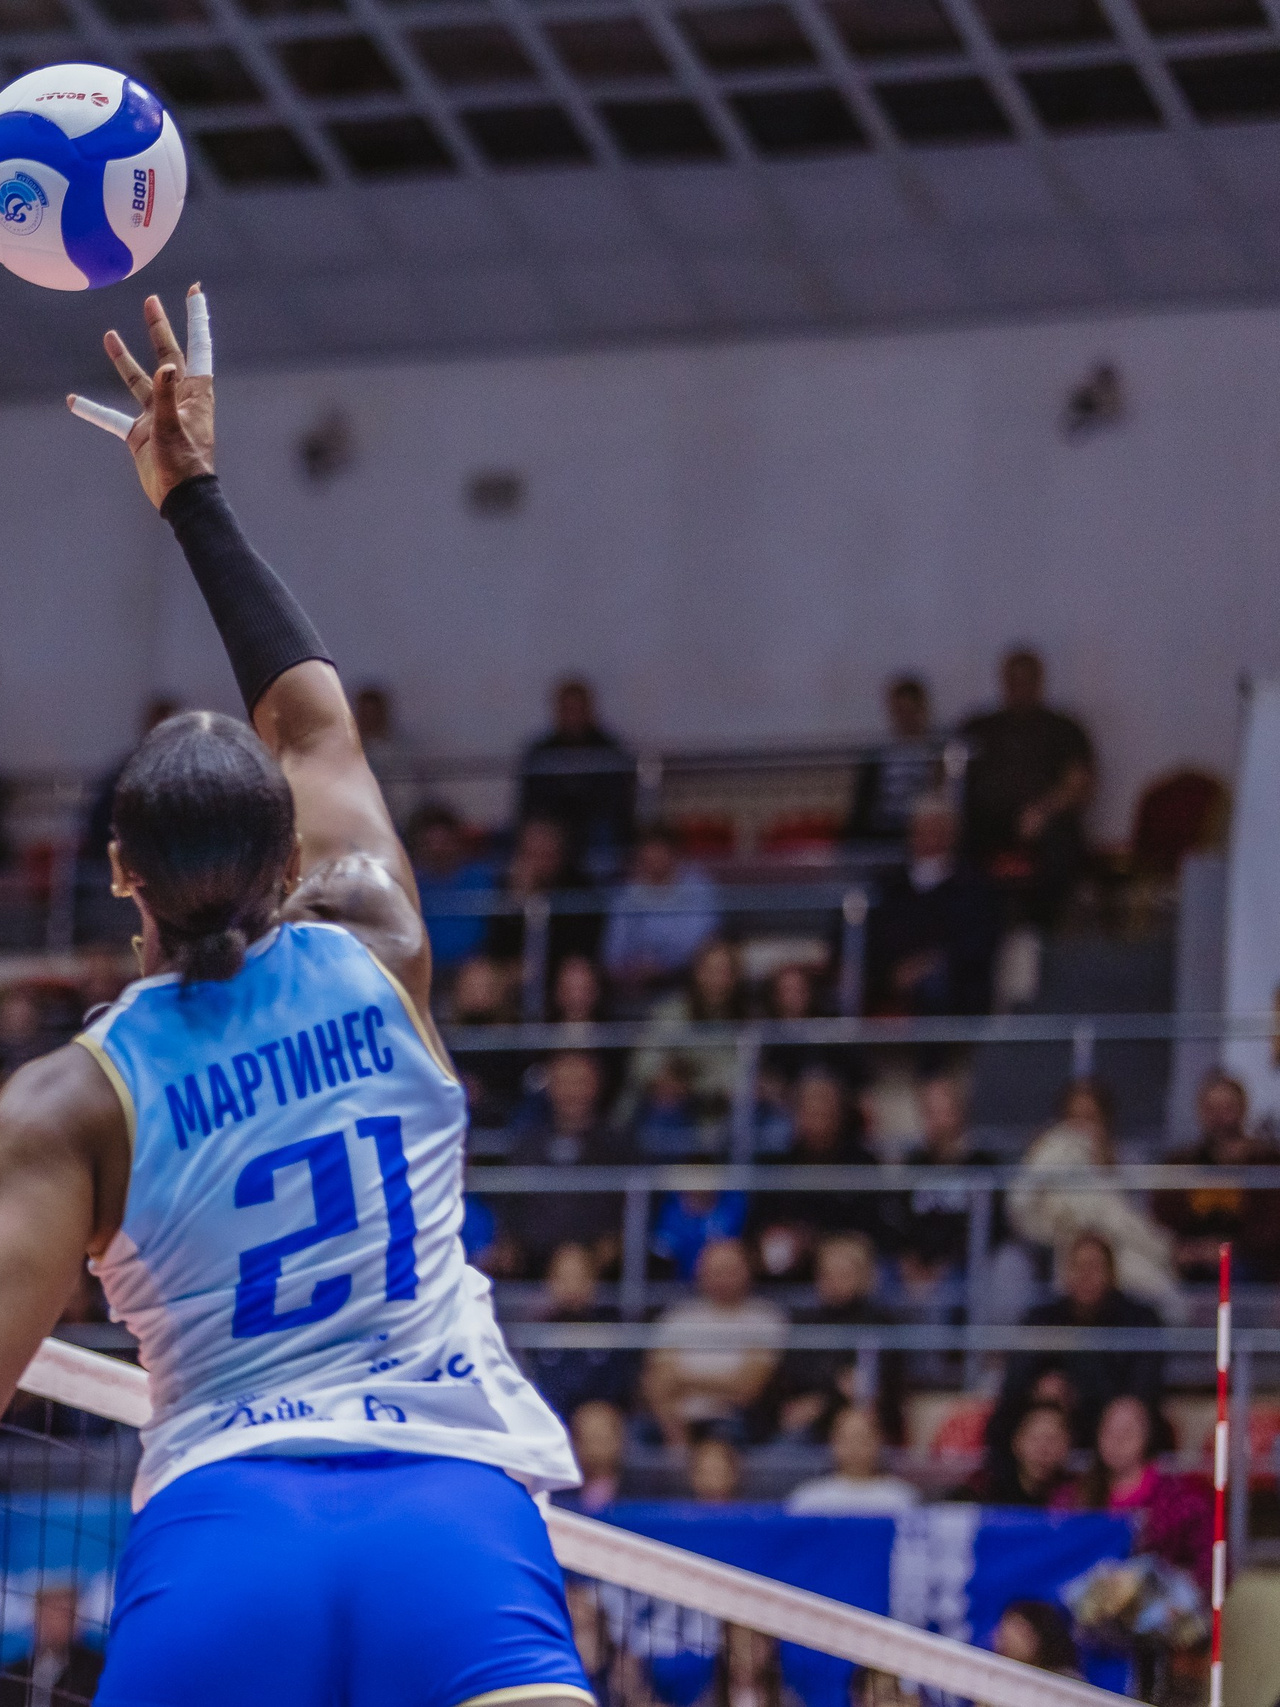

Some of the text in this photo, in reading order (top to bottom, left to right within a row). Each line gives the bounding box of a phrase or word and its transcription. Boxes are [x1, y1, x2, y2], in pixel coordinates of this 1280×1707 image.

[132, 168, 147, 212] ВФВ
[164, 1005, 394, 1150] МАРТИНЕС
[232, 1115, 419, 1339] 21
